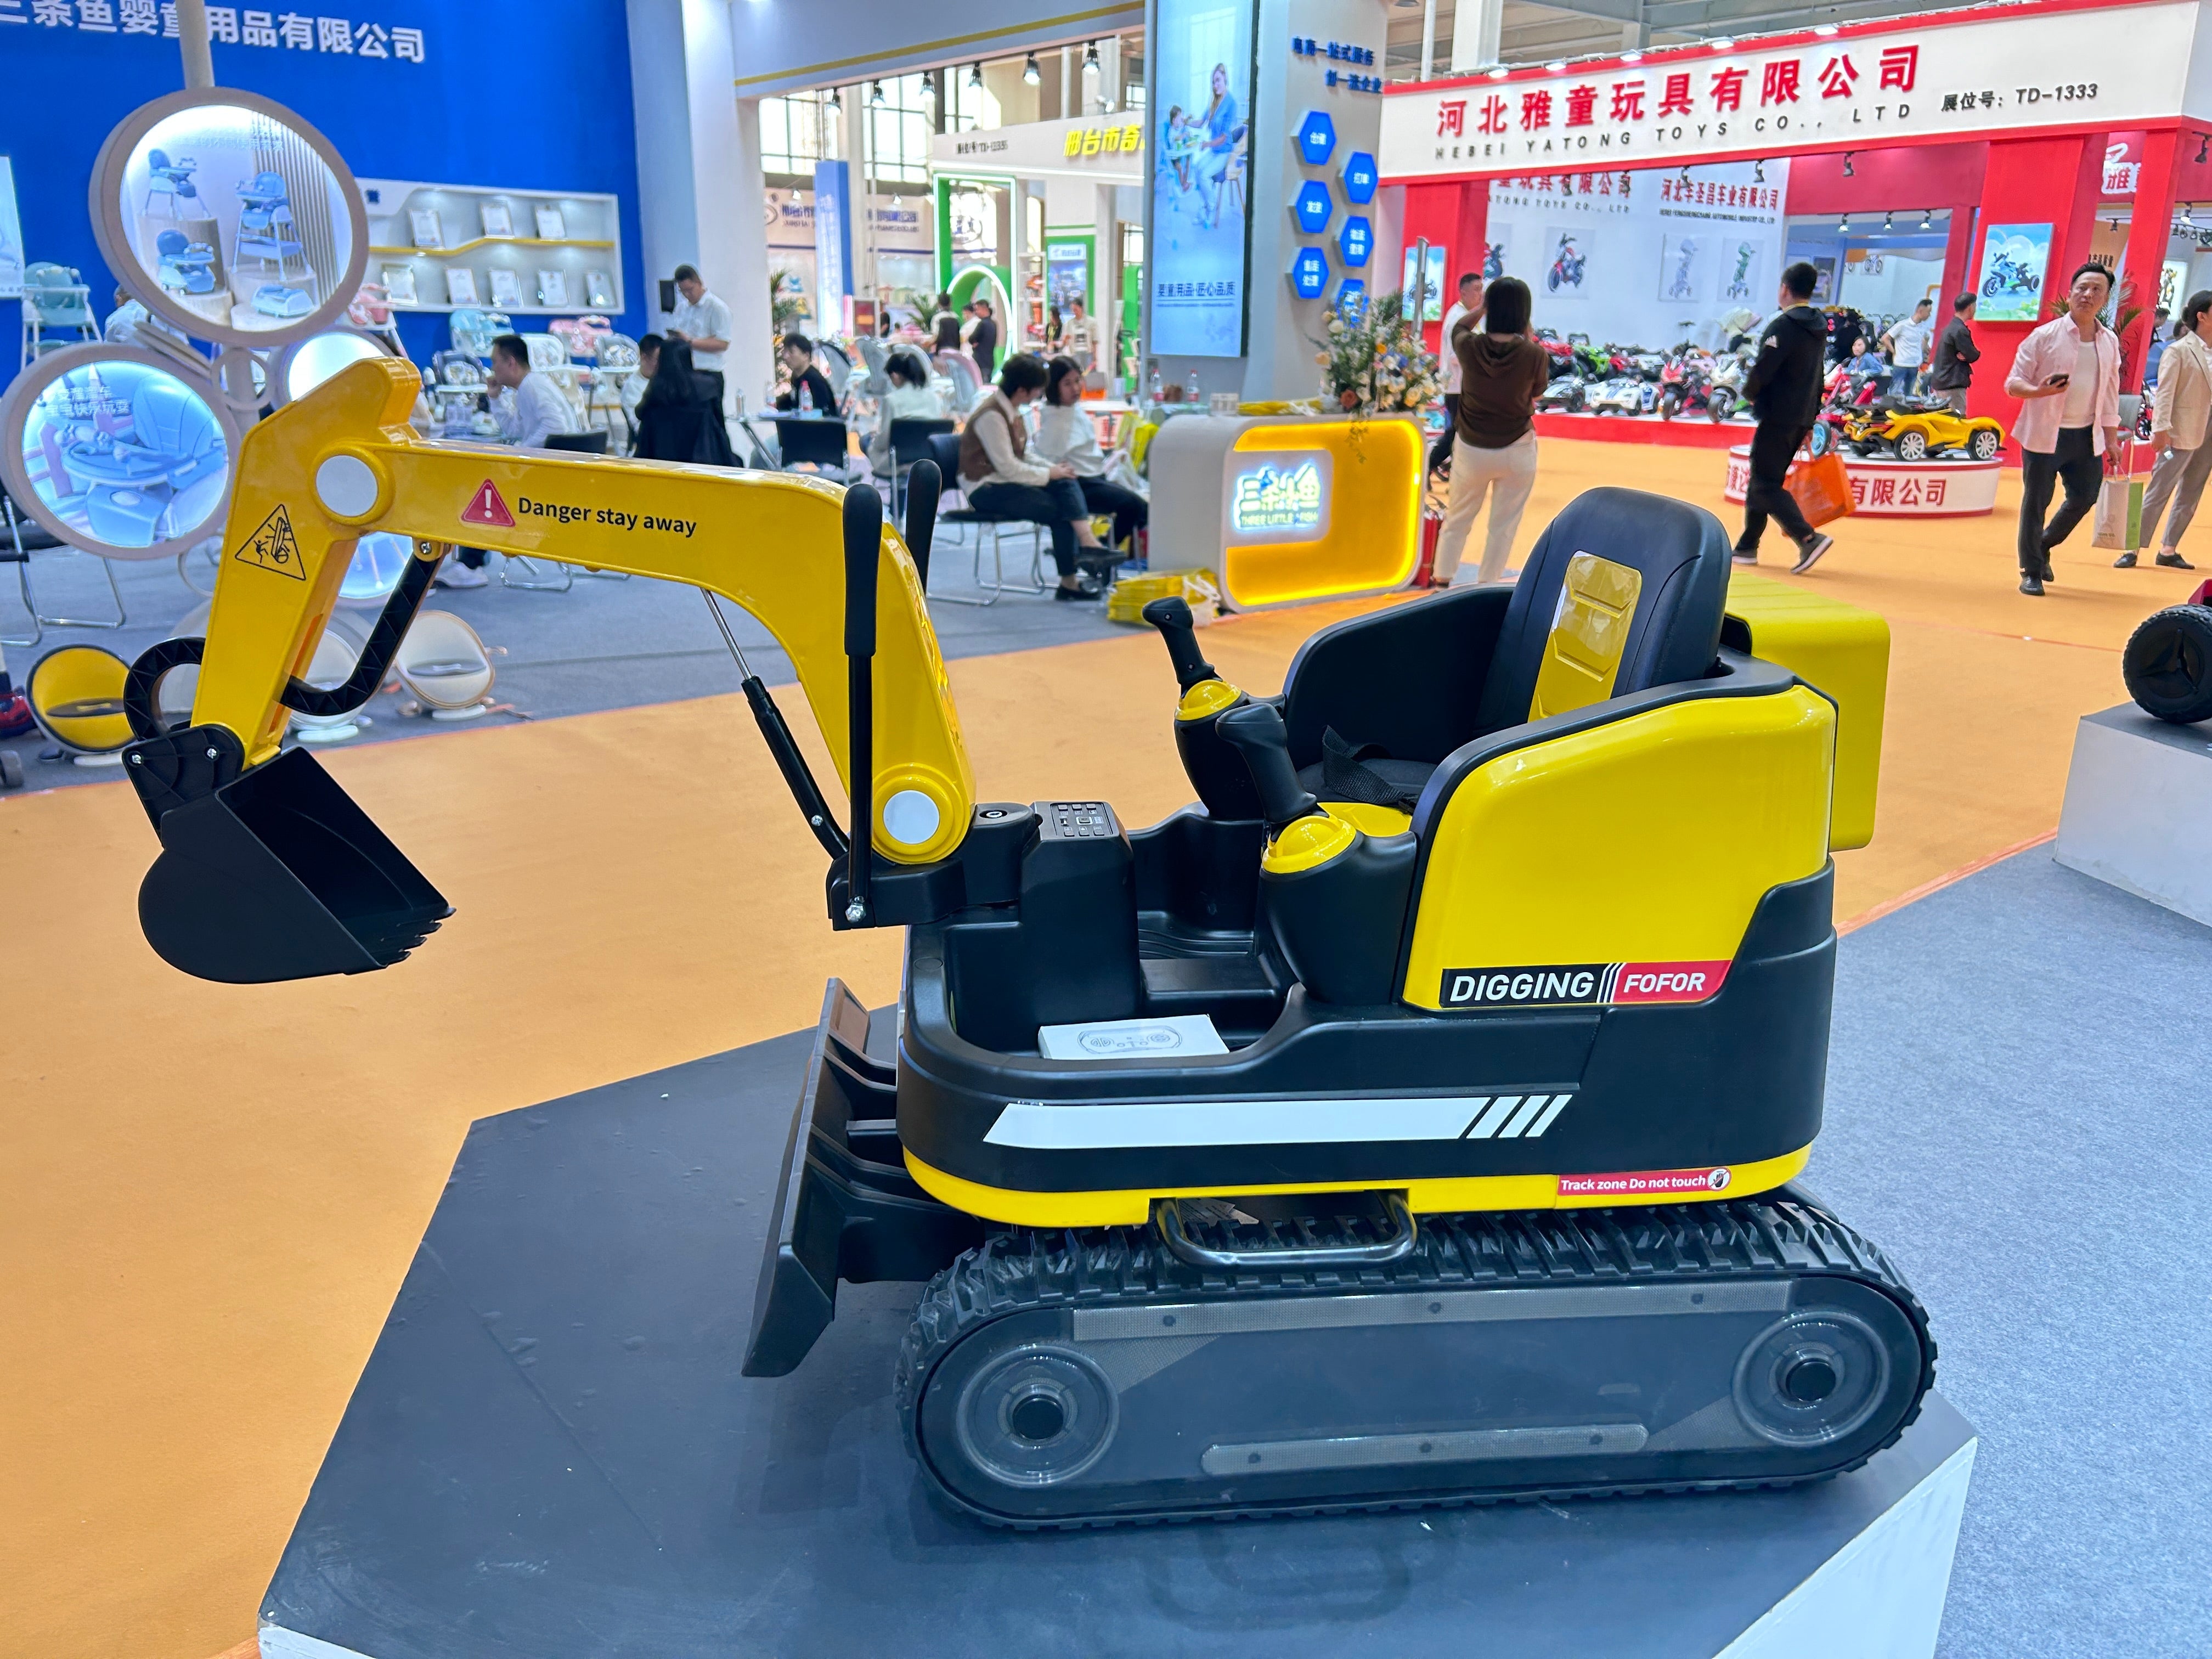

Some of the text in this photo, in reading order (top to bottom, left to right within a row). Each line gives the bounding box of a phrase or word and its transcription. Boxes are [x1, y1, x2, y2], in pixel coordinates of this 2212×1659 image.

[1436, 44, 1920, 137] 河北雅童玩具有限公司
[2016, 82, 2099, 105] TD-1333
[1063, 123, 1146, 157] 邢台市奇
[1435, 104, 1910, 160] HEBEI YATONG TOYS CO., LTD
[2106, 166, 2142, 189] 雅
[518, 497, 697, 538] Danger stay away
[1240, 515, 1266, 527] THREE
[1267, 512, 1294, 524] LITTLE
[1449, 972, 1706, 1002] DIGGING FOFOR
[1561, 1175, 1706, 1191] Track zone Do not touch
